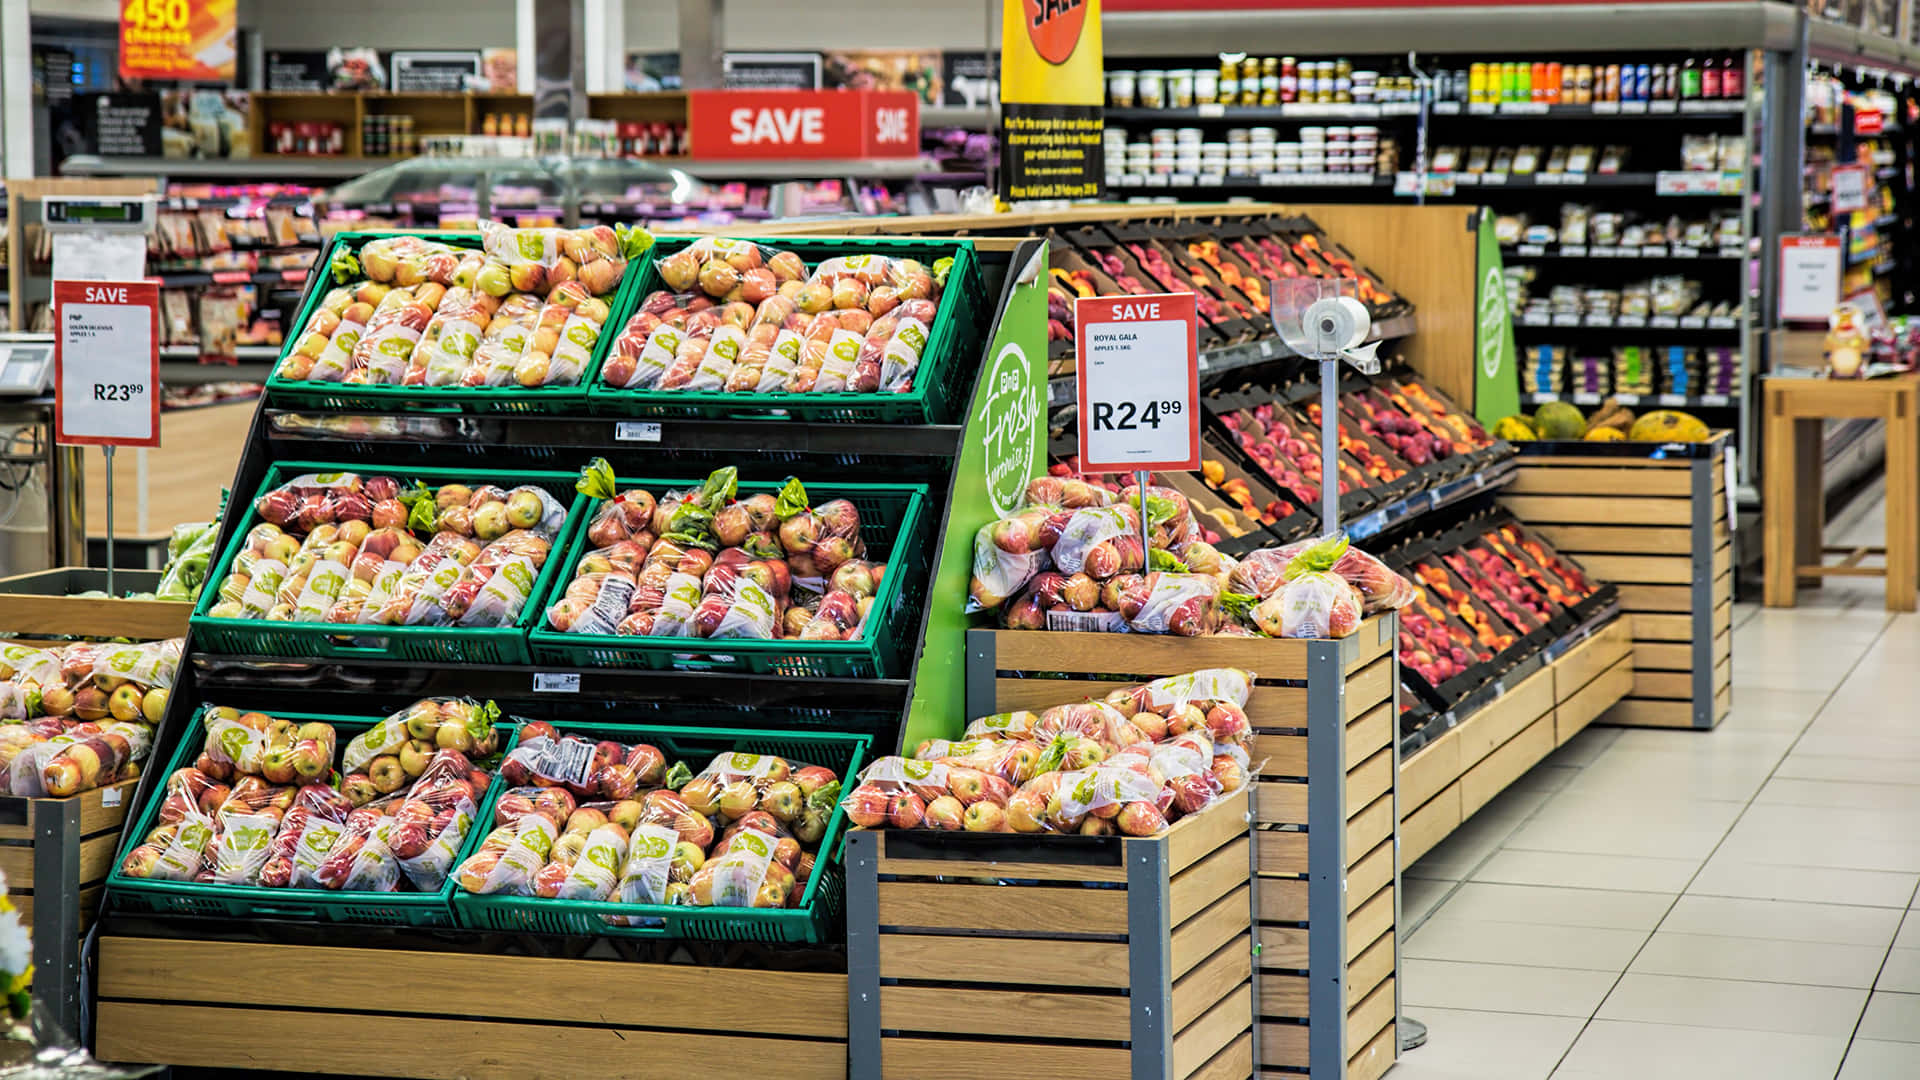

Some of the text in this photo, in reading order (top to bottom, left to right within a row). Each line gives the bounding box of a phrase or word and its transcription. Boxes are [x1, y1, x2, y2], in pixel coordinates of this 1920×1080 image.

[124, 0, 189, 28] 450
[731, 108, 824, 144] SAVE
[876, 108, 908, 143] SAVE
[85, 287, 128, 303] SAVE
[1112, 303, 1160, 320] SAVE
[1094, 333, 1138, 342] ROYAL GALA
[979, 361, 1041, 457] Fresh
